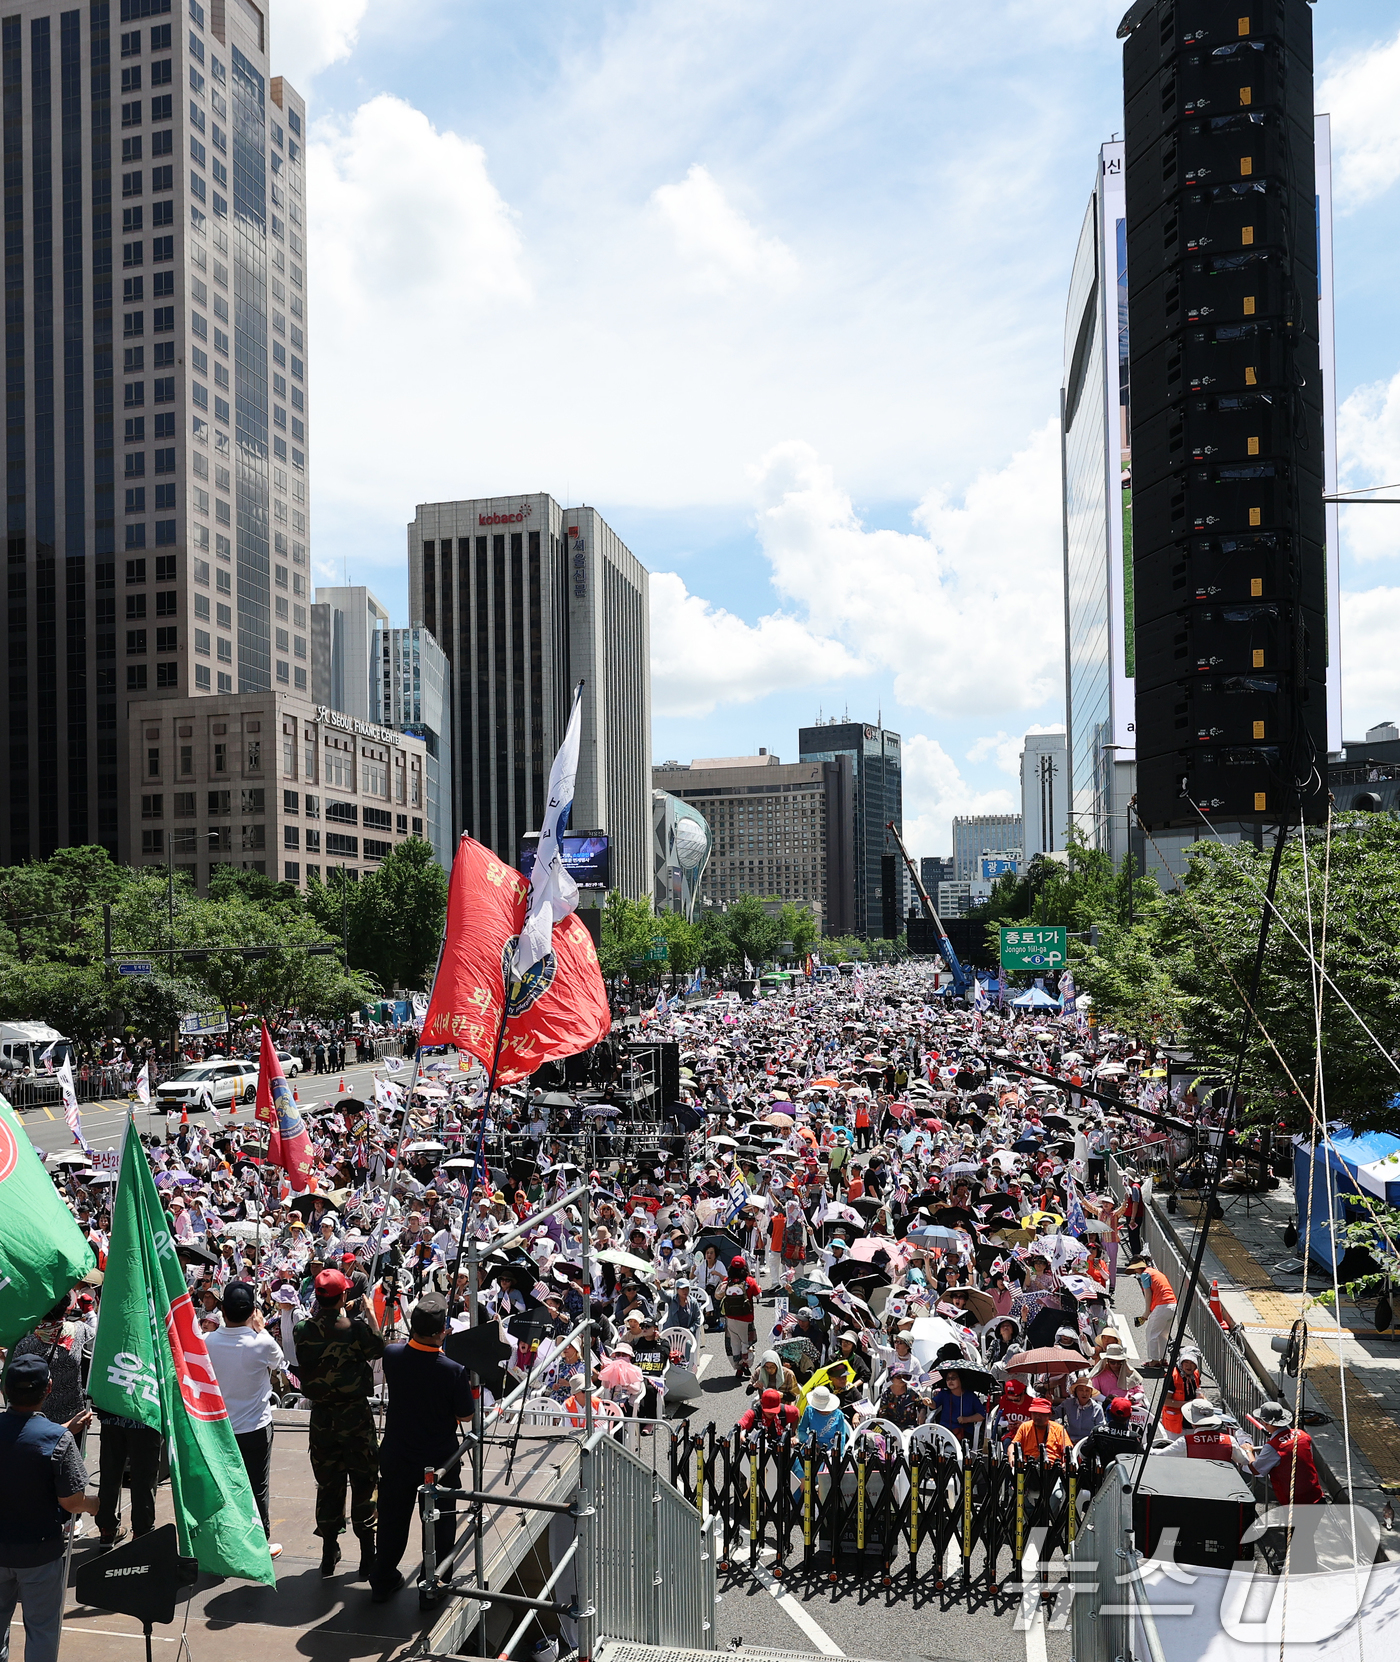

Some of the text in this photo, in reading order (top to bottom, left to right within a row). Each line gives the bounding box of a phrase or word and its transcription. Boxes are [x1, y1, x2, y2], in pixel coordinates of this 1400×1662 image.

[479, 511, 523, 526] kobaco
[573, 539, 587, 598] 서울신문
[1005, 930, 1060, 944] 종로1가
[1005, 946, 1027, 955] Jongno
[1193, 1435, 1225, 1443] STAFF
[104, 1565, 151, 1578] SHURE
